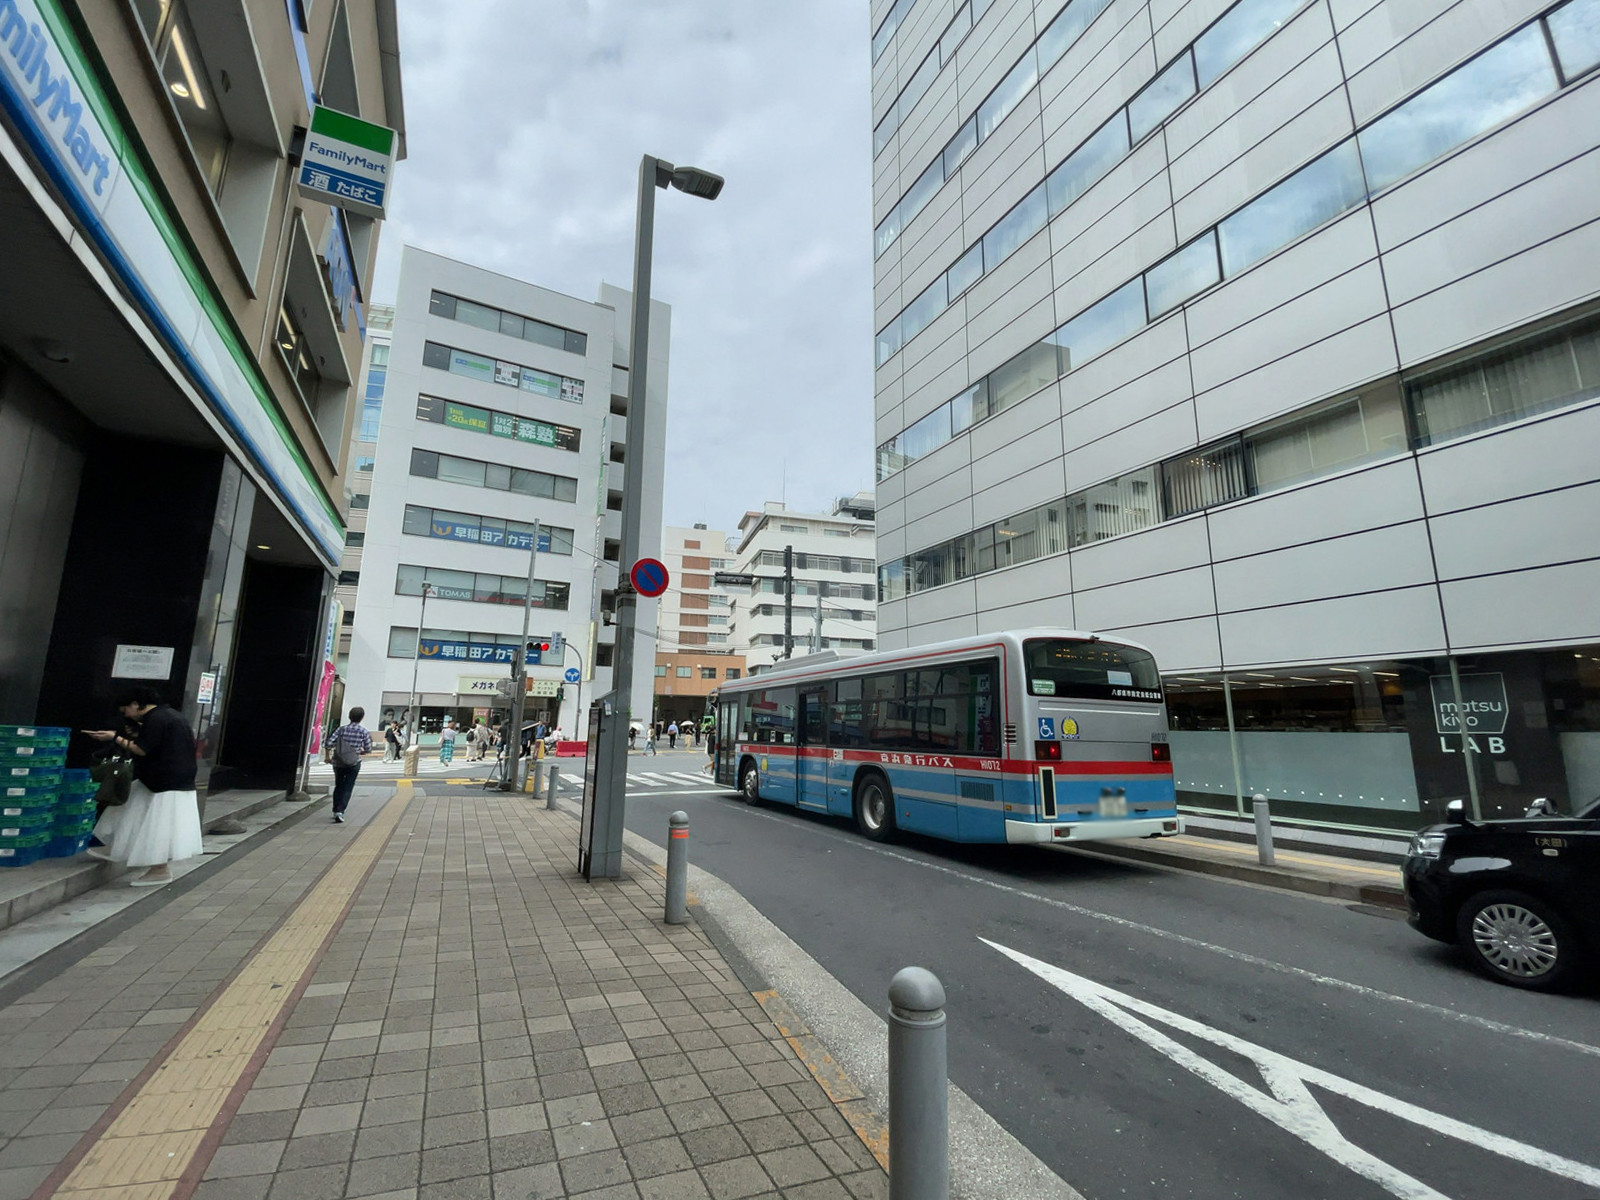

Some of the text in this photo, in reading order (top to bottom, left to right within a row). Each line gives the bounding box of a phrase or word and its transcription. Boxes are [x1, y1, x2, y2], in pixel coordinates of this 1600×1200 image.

[309, 141, 386, 174] FamilyMart
[308, 171, 377, 203] 酒 たばこ
[518, 422, 554, 444] 森塾
[440, 589, 472, 599] TOMAS
[441, 645, 539, 661] 早稲田アカデー
[1439, 700, 1502, 713] matsu
[1439, 736, 1506, 754] LAB
[880, 753, 955, 768] 京浜急行バス
